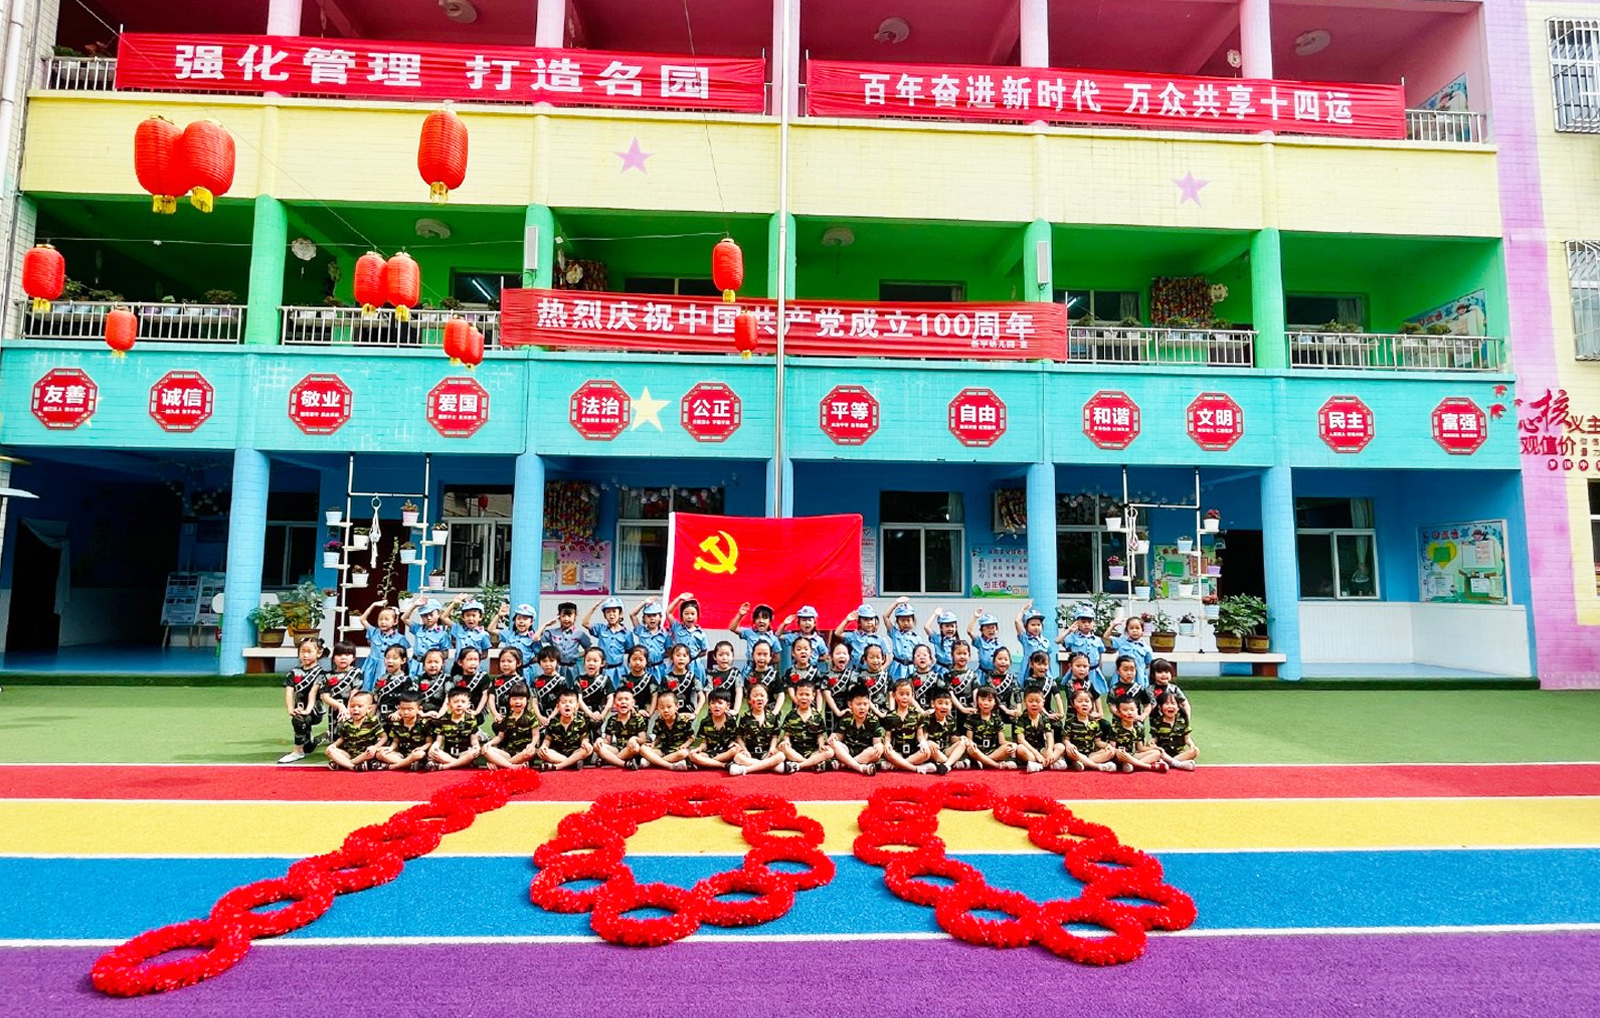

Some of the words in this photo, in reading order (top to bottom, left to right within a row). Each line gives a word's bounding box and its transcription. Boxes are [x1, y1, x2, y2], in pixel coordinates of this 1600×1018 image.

[174, 44, 422, 87] 强化管理
[465, 55, 709, 99] 打造名园
[859, 73, 1102, 112] 百年奋进新时代
[1123, 82, 1353, 124] 万众共享十四运
[536, 298, 1036, 341] 热烈庆祝中国共产党成立100周年
[43, 385, 87, 405] 友善
[161, 387, 203, 407] 诚信
[300, 390, 341, 408] 敬业
[438, 394, 478, 413] 爱国
[581, 396, 620, 416] 法治
[692, 399, 731, 418] 公正
[830, 401, 869, 421] 平等
[960, 404, 996, 423] 自由
[1093, 407, 1130, 426] 和谐
[1196, 408, 1233, 427] 文明
[1328, 411, 1364, 430] 民主
[1441, 413, 1478, 432] 富强
